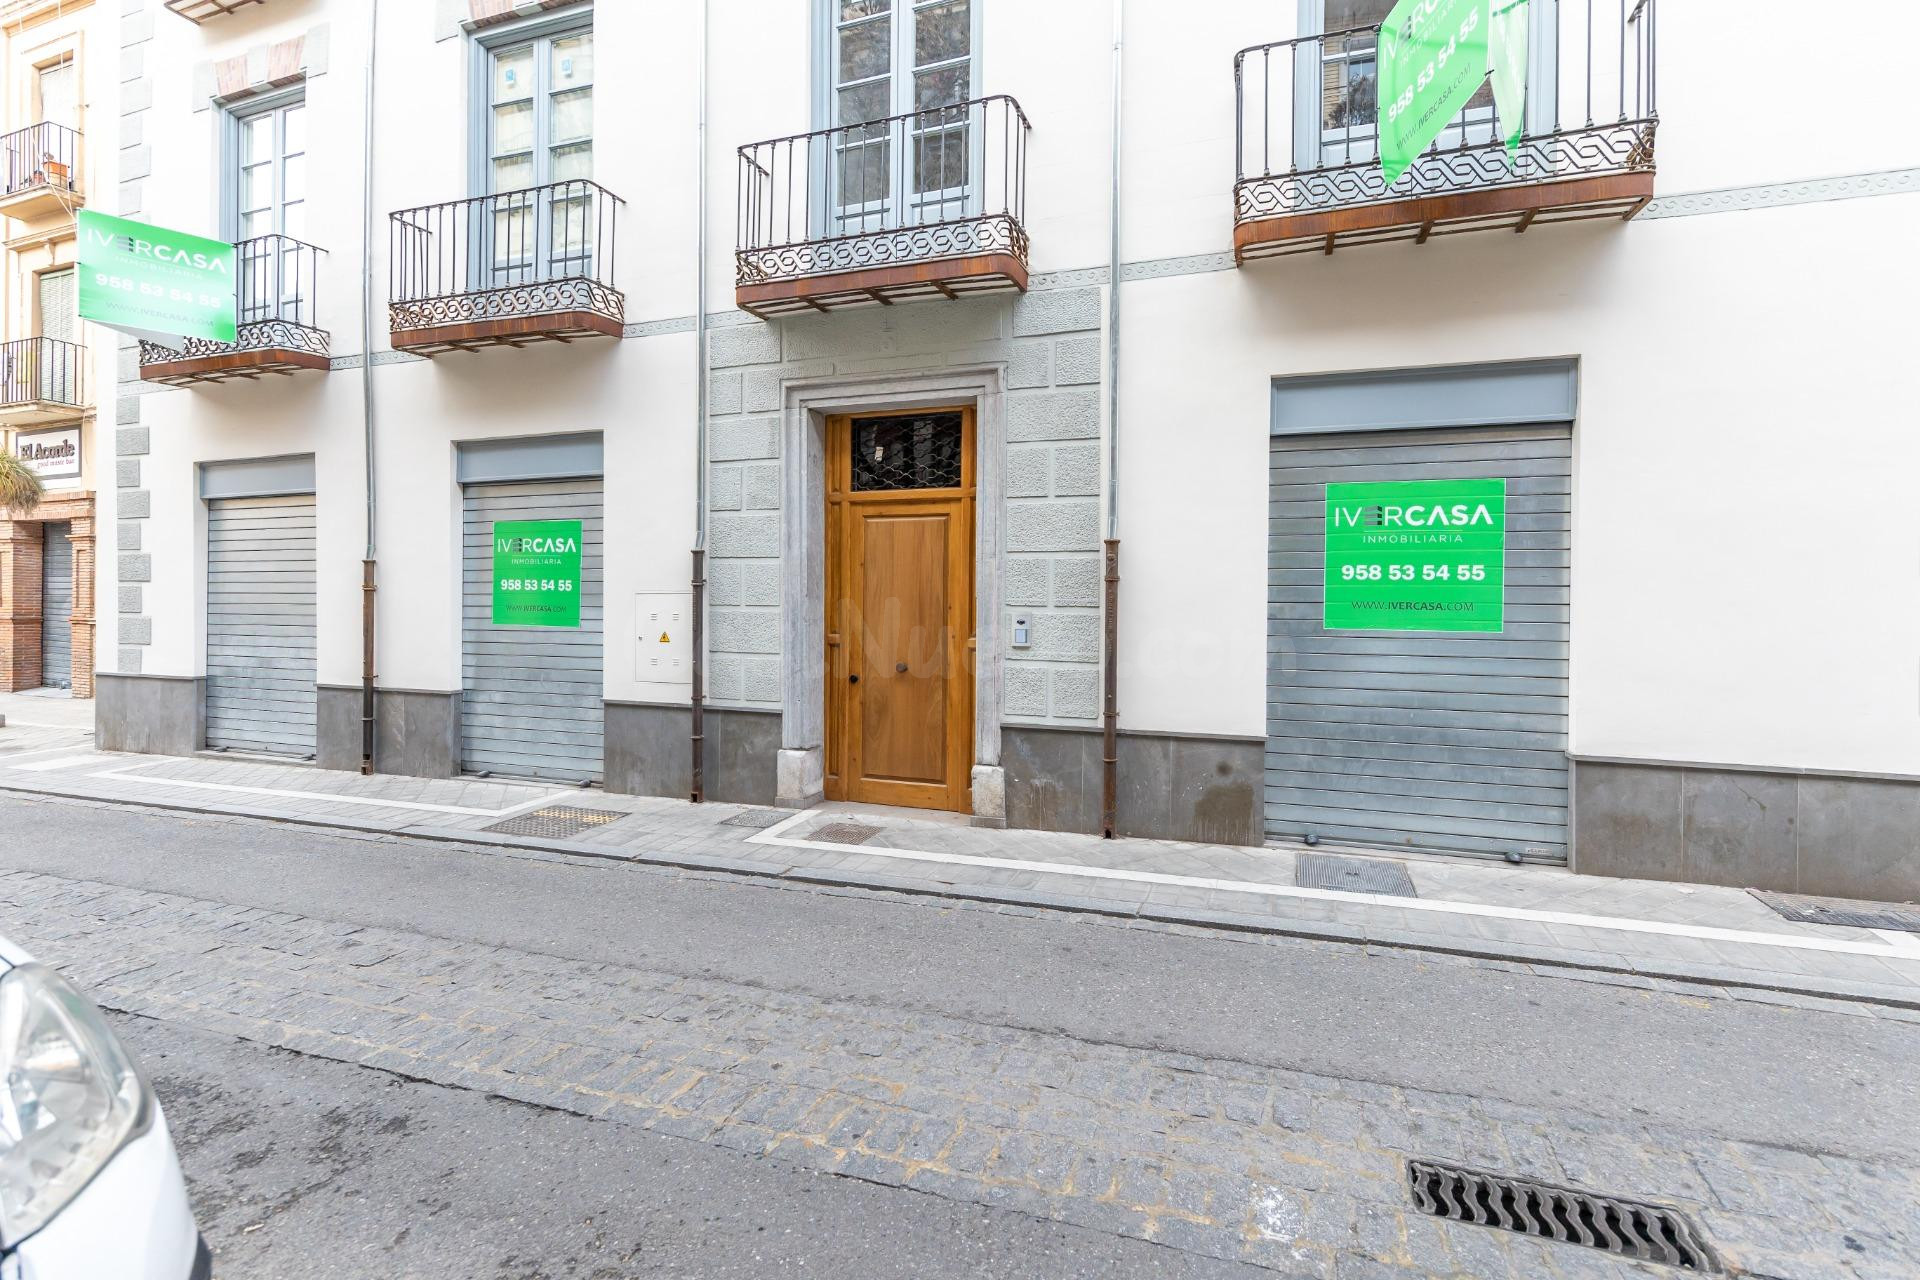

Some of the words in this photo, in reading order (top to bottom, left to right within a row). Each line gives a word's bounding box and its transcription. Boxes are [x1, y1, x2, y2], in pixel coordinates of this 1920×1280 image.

[1389, 85, 1414, 123] 958
[1417, 61, 1434, 93] 53
[1438, 34, 1456, 69] 54
[1460, 6, 1478, 43] 55
[1396, 63, 1471, 150] WWW.IVERCASA.COM
[116, 255, 203, 279] INMOBILIARIA
[96, 273, 134, 291] 958
[140, 281, 164, 298] 53
[170, 288, 193, 304] 54
[198, 293, 222, 309] 55
[106, 302, 214, 327] WWW.IVERCASA.COM
[20, 443, 34, 461] El
[34, 439, 76, 460] Acorde
[1362, 534, 1464, 544] INMOBILIARIA
[1341, 564, 1382, 581] 958
[1387, 564, 1415, 581] 53
[1421, 564, 1450, 581] 54
[1456, 564, 1486, 581] 55
[500, 579, 521, 591] 958
[524, 579, 538, 591] 53
[540, 579, 555, 592] 54
[557, 579, 573, 592] 55
[506, 604, 567, 614] WWW.IVERCASA.COM
[1351, 600, 1475, 613] WWW.IVERCASA.COM
